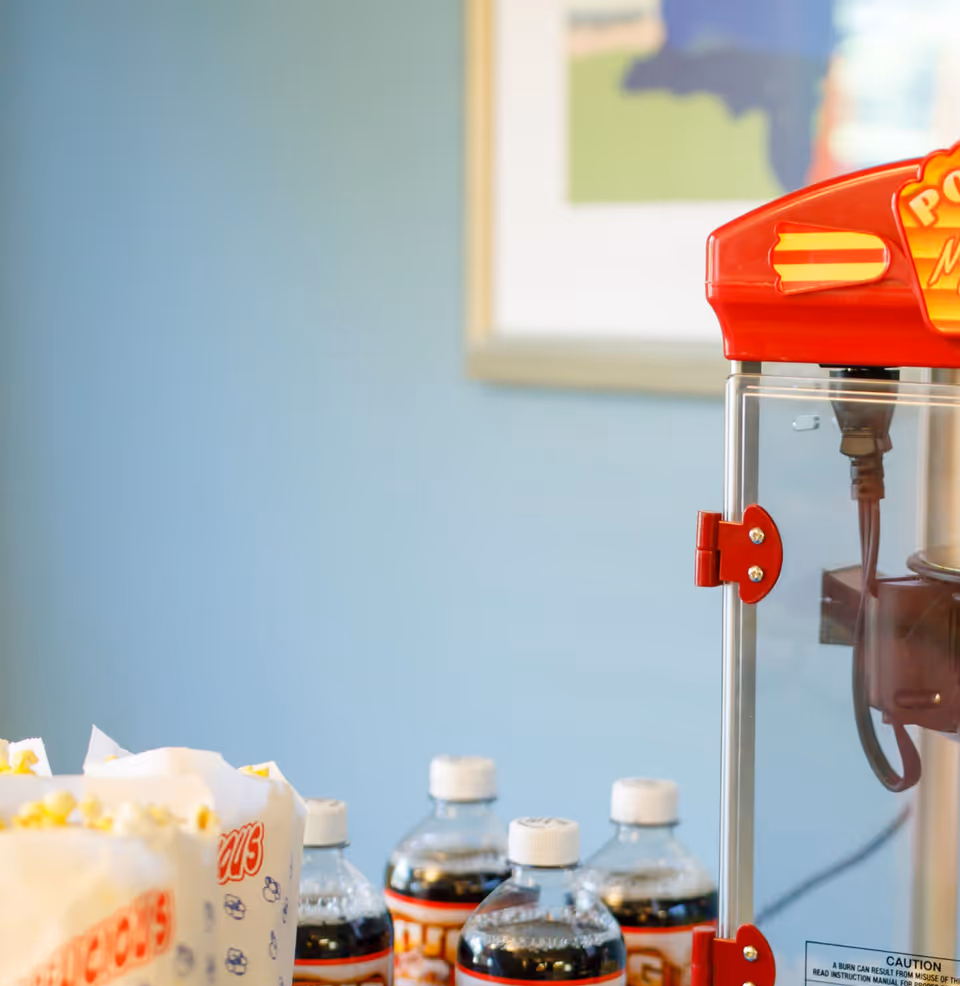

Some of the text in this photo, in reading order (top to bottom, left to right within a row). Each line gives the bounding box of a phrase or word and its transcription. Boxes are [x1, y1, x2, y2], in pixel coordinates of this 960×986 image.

[832, 961, 838, 969] A
[838, 962, 856, 971] BURN
[856, 965, 870, 973] CAN
[871, 967, 894, 977] RESULT
[895, 970, 914, 979] FROM
[915, 972, 939, 982] MISUSE
[940, 975, 949, 983] OF
[885, 955, 942, 973] CAUTION
[812, 968, 829, 977] READ
[830, 970, 871, 982] INSTRUCTION
[872, 975, 899, 986] MANUAL
